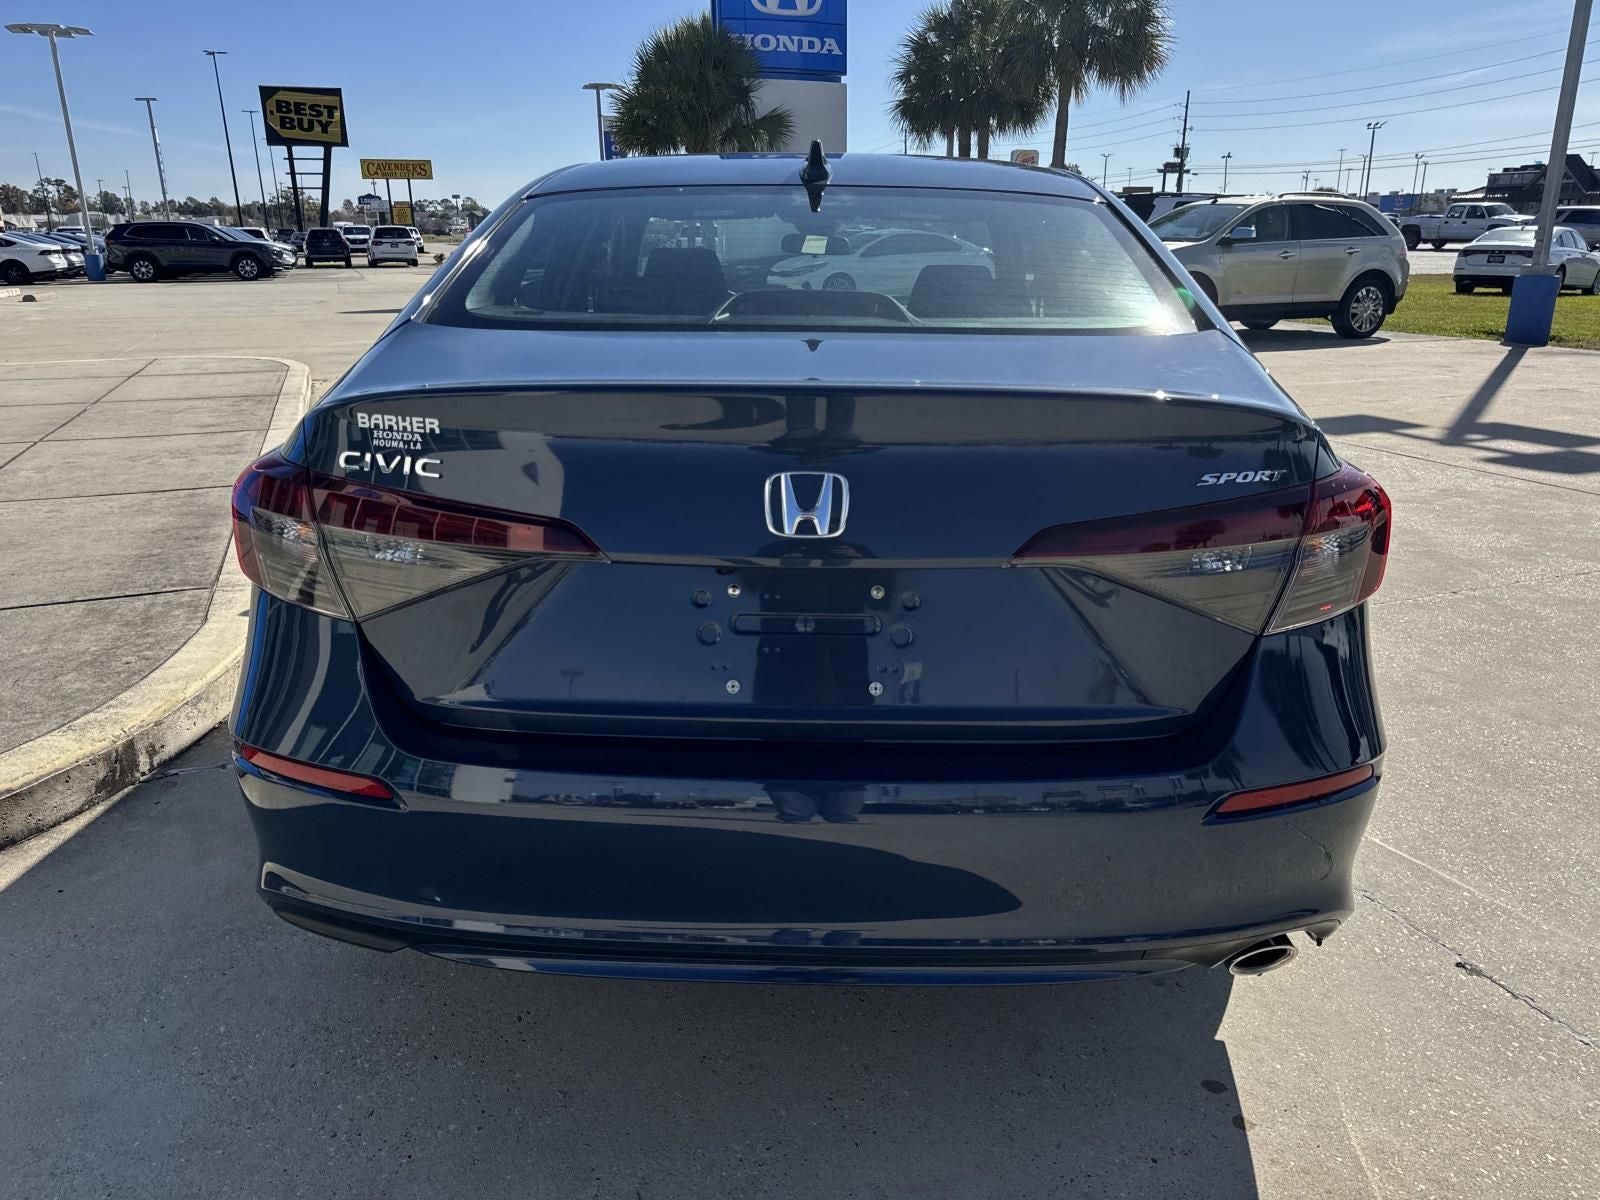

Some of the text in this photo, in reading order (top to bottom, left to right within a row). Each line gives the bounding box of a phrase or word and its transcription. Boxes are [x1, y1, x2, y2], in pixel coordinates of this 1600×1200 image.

[276, 99, 338, 119] BEST
[279, 115, 333, 134] BUY
[357, 412, 440, 434] BARKER
[373, 430, 422, 442] HONDA
[410, 441, 422, 450] LA
[339, 451, 442, 478] CIVIC
[1196, 469, 1288, 487] SPORT
